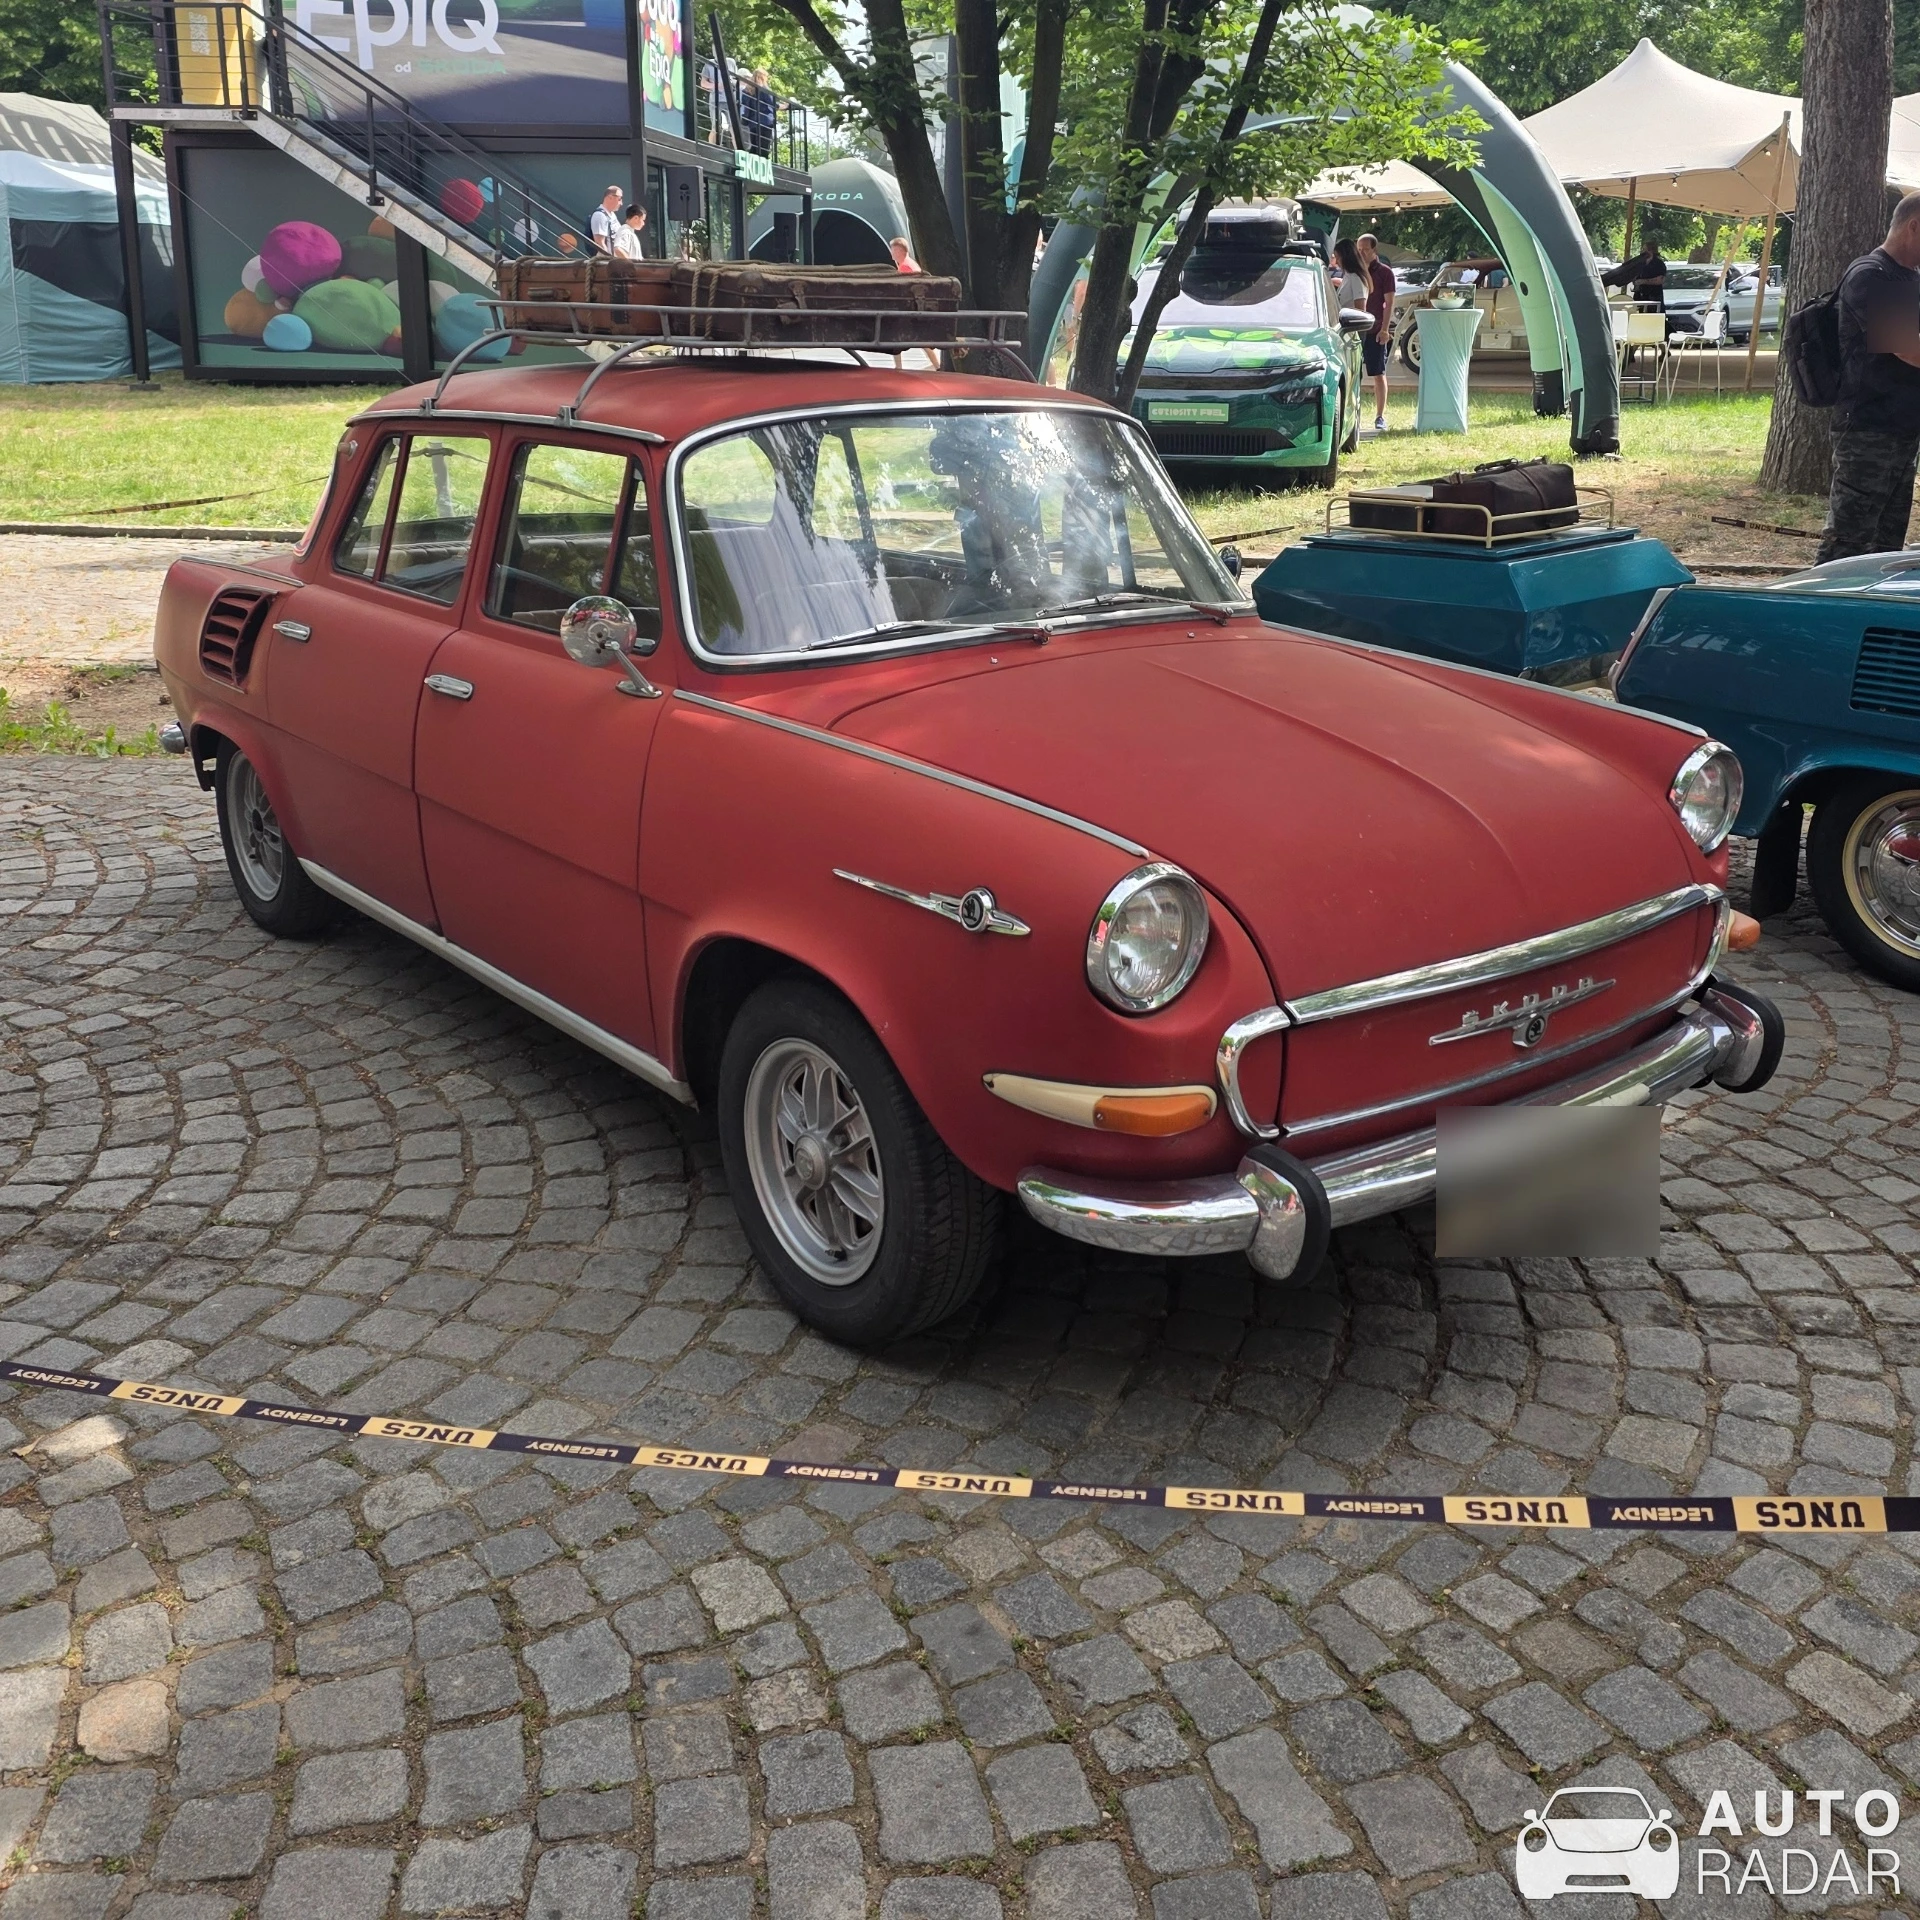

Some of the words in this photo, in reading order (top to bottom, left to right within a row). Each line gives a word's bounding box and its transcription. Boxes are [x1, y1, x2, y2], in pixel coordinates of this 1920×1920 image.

[394, 61, 412, 73] od
[812, 192, 865, 201] KODA
[1151, 407, 1198, 417] CURIOSITY
[1200, 408, 1226, 417] FUEL
[1750, 522, 1772, 532] UNCS
[9, 1368, 101, 1390] LEGENDY
[130, 1386, 225, 1411] UNCS
[256, 1407, 349, 1426] LEGENDY
[380, 1422, 475, 1444] UNCS
[525, 1440, 619, 1458] LEGENDY
[653, 1452, 747, 1472] UNCS
[784, 1465, 880, 1482] LEGENDY
[916, 1475, 1011, 1493] UNCS
[1051, 1485, 1147, 1500] LEGENDY
[1186, 1491, 1285, 1511] UNCS
[1325, 1500, 1425, 1515] LEGENDY
[1464, 1501, 1569, 1524] UNCS
[1611, 1507, 1714, 1522] LEGENDY
[1755, 1501, 1866, 1528] UNCS
